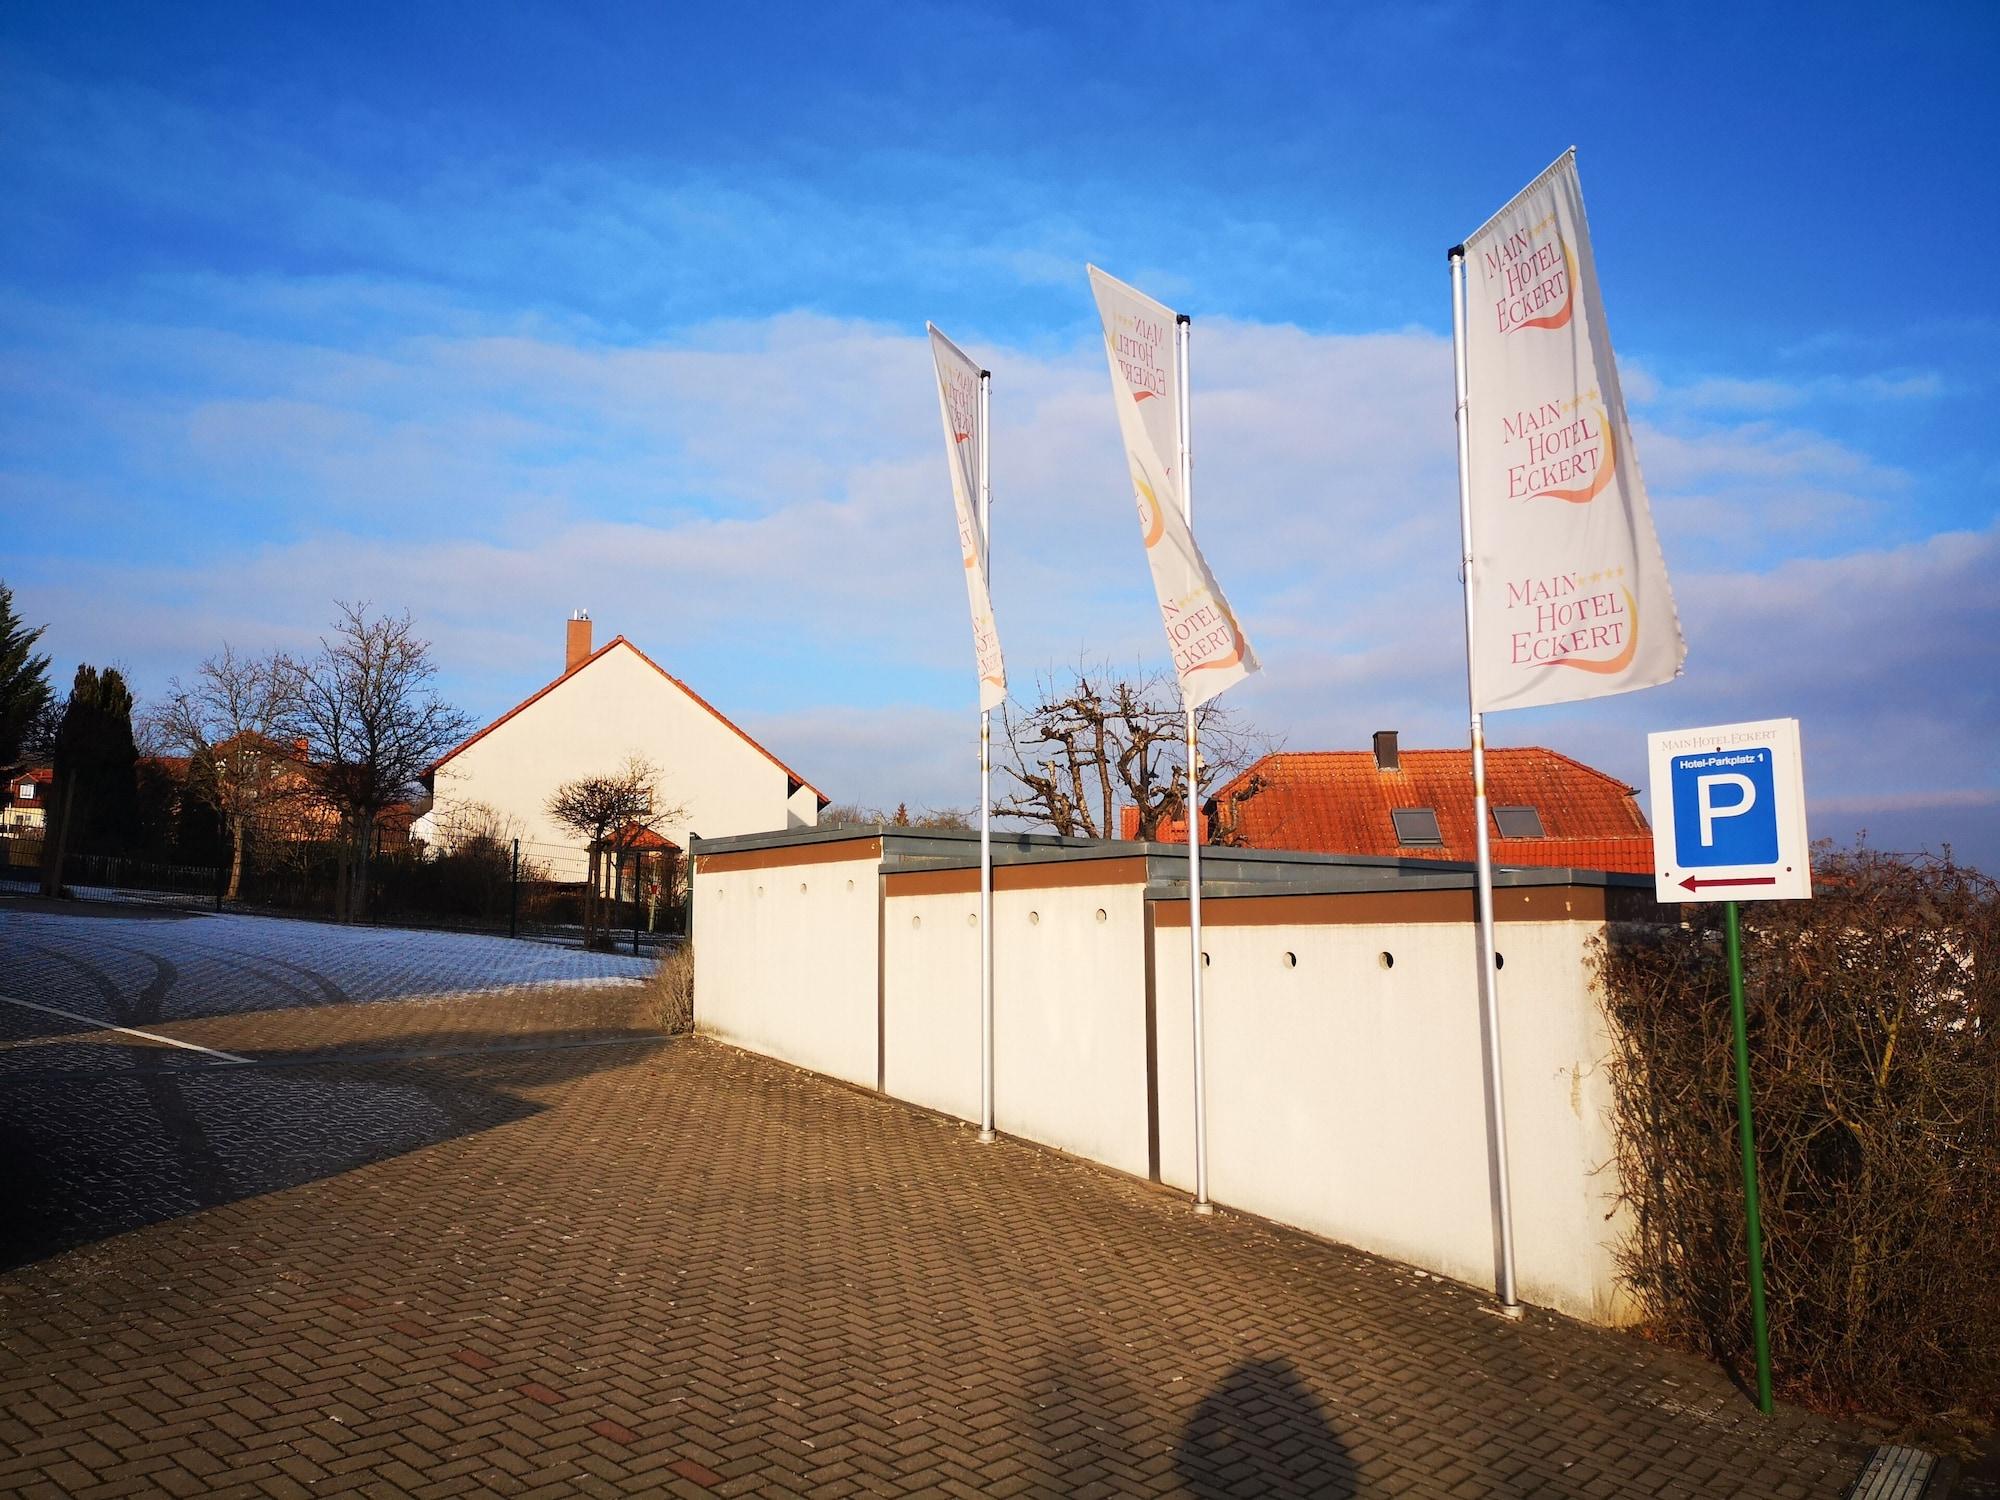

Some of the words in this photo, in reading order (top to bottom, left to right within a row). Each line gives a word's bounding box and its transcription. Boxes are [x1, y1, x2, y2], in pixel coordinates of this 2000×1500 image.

[1486, 228, 1528, 279] MAIN
[1506, 241, 1561, 298] HOTEL
[1496, 271, 1564, 333] ECKERT
[1502, 399, 1560, 444] MAIN
[1528, 418, 1598, 465] HOTEL
[1508, 447, 1598, 499] ECKERT
[1507, 572, 1576, 609] MAIN
[1537, 592, 1623, 633] HOTEL
[1174, 625, 1230, 671] CKERT
[1512, 622, 1623, 664] ECKERT
[1680, 755, 1755, 769] Hotel-Parkplatz
[1757, 753, 1764, 762] 1
[1697, 773, 1756, 847] P
